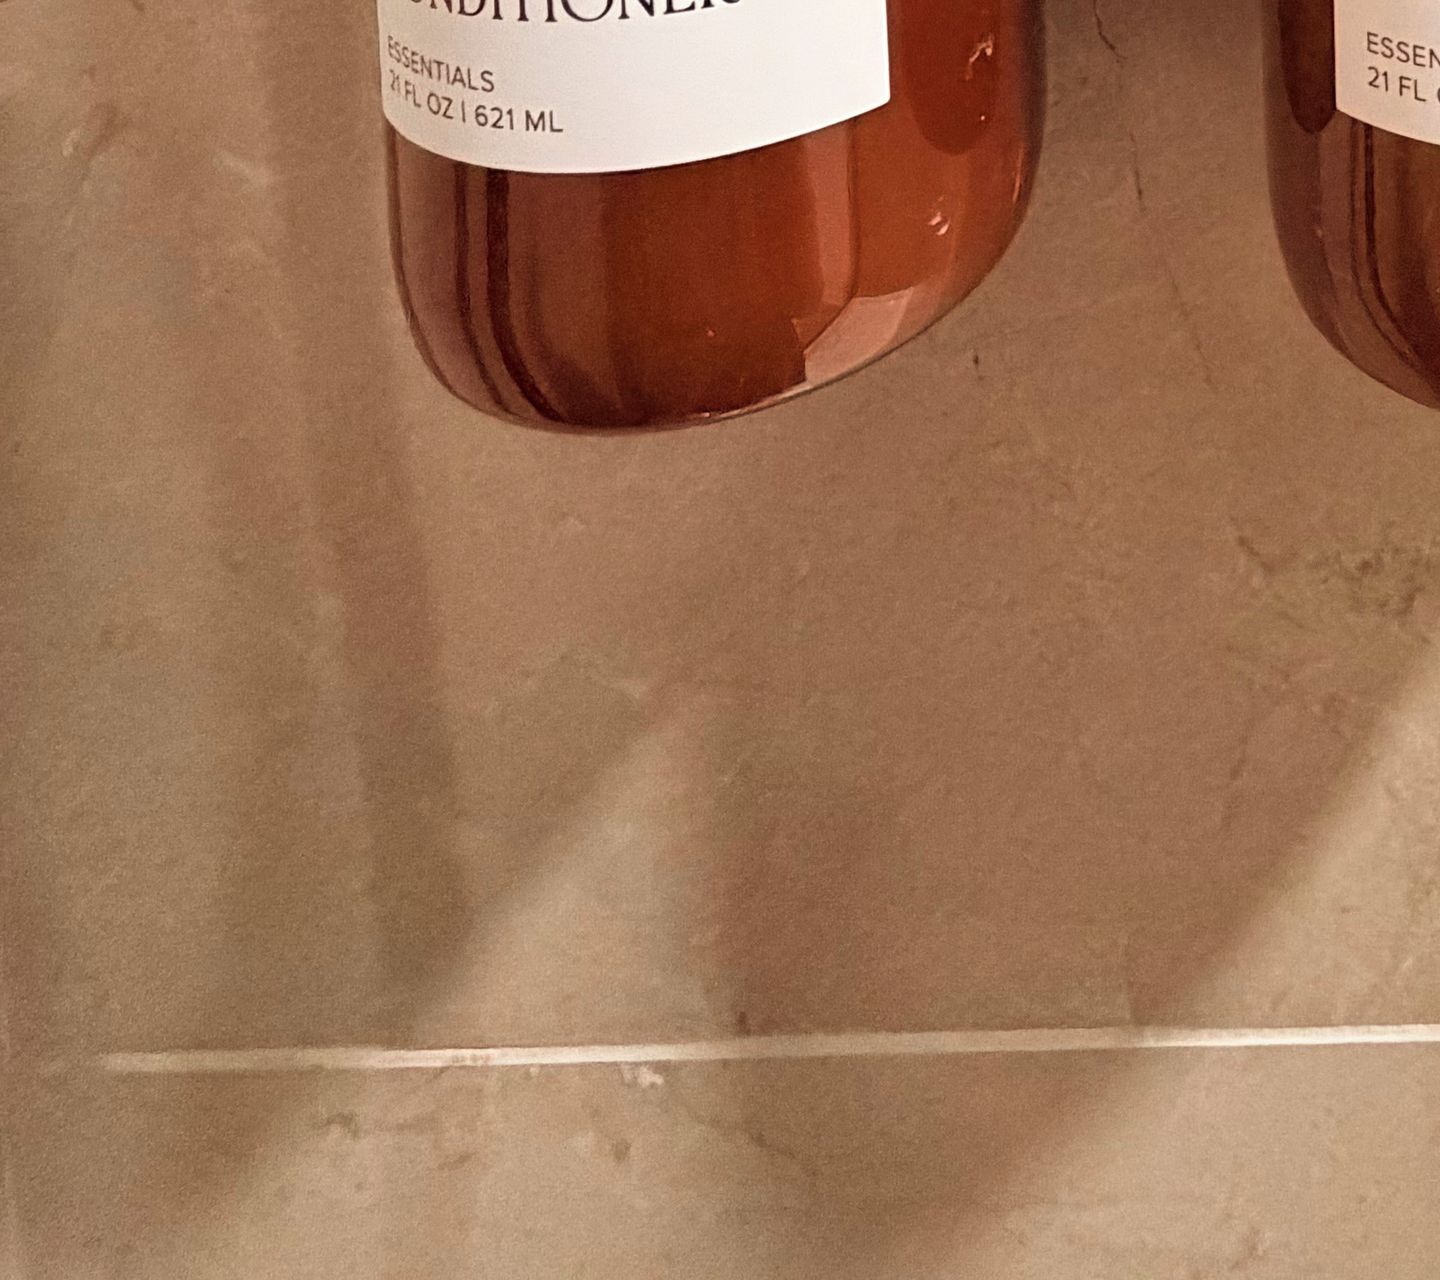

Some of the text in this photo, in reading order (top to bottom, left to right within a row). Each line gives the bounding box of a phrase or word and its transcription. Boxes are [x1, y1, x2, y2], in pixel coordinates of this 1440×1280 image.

[387, 35, 495, 93] ESSENTIALS
[1367, 66, 1389, 92] 21
[1399, 75, 1427, 102] FL
[389, 69, 400, 93] 21
[404, 80, 421, 108] FL
[427, 92, 455, 120] OZ
[474, 104, 515, 130] 621
[525, 109, 564, 133] ML
